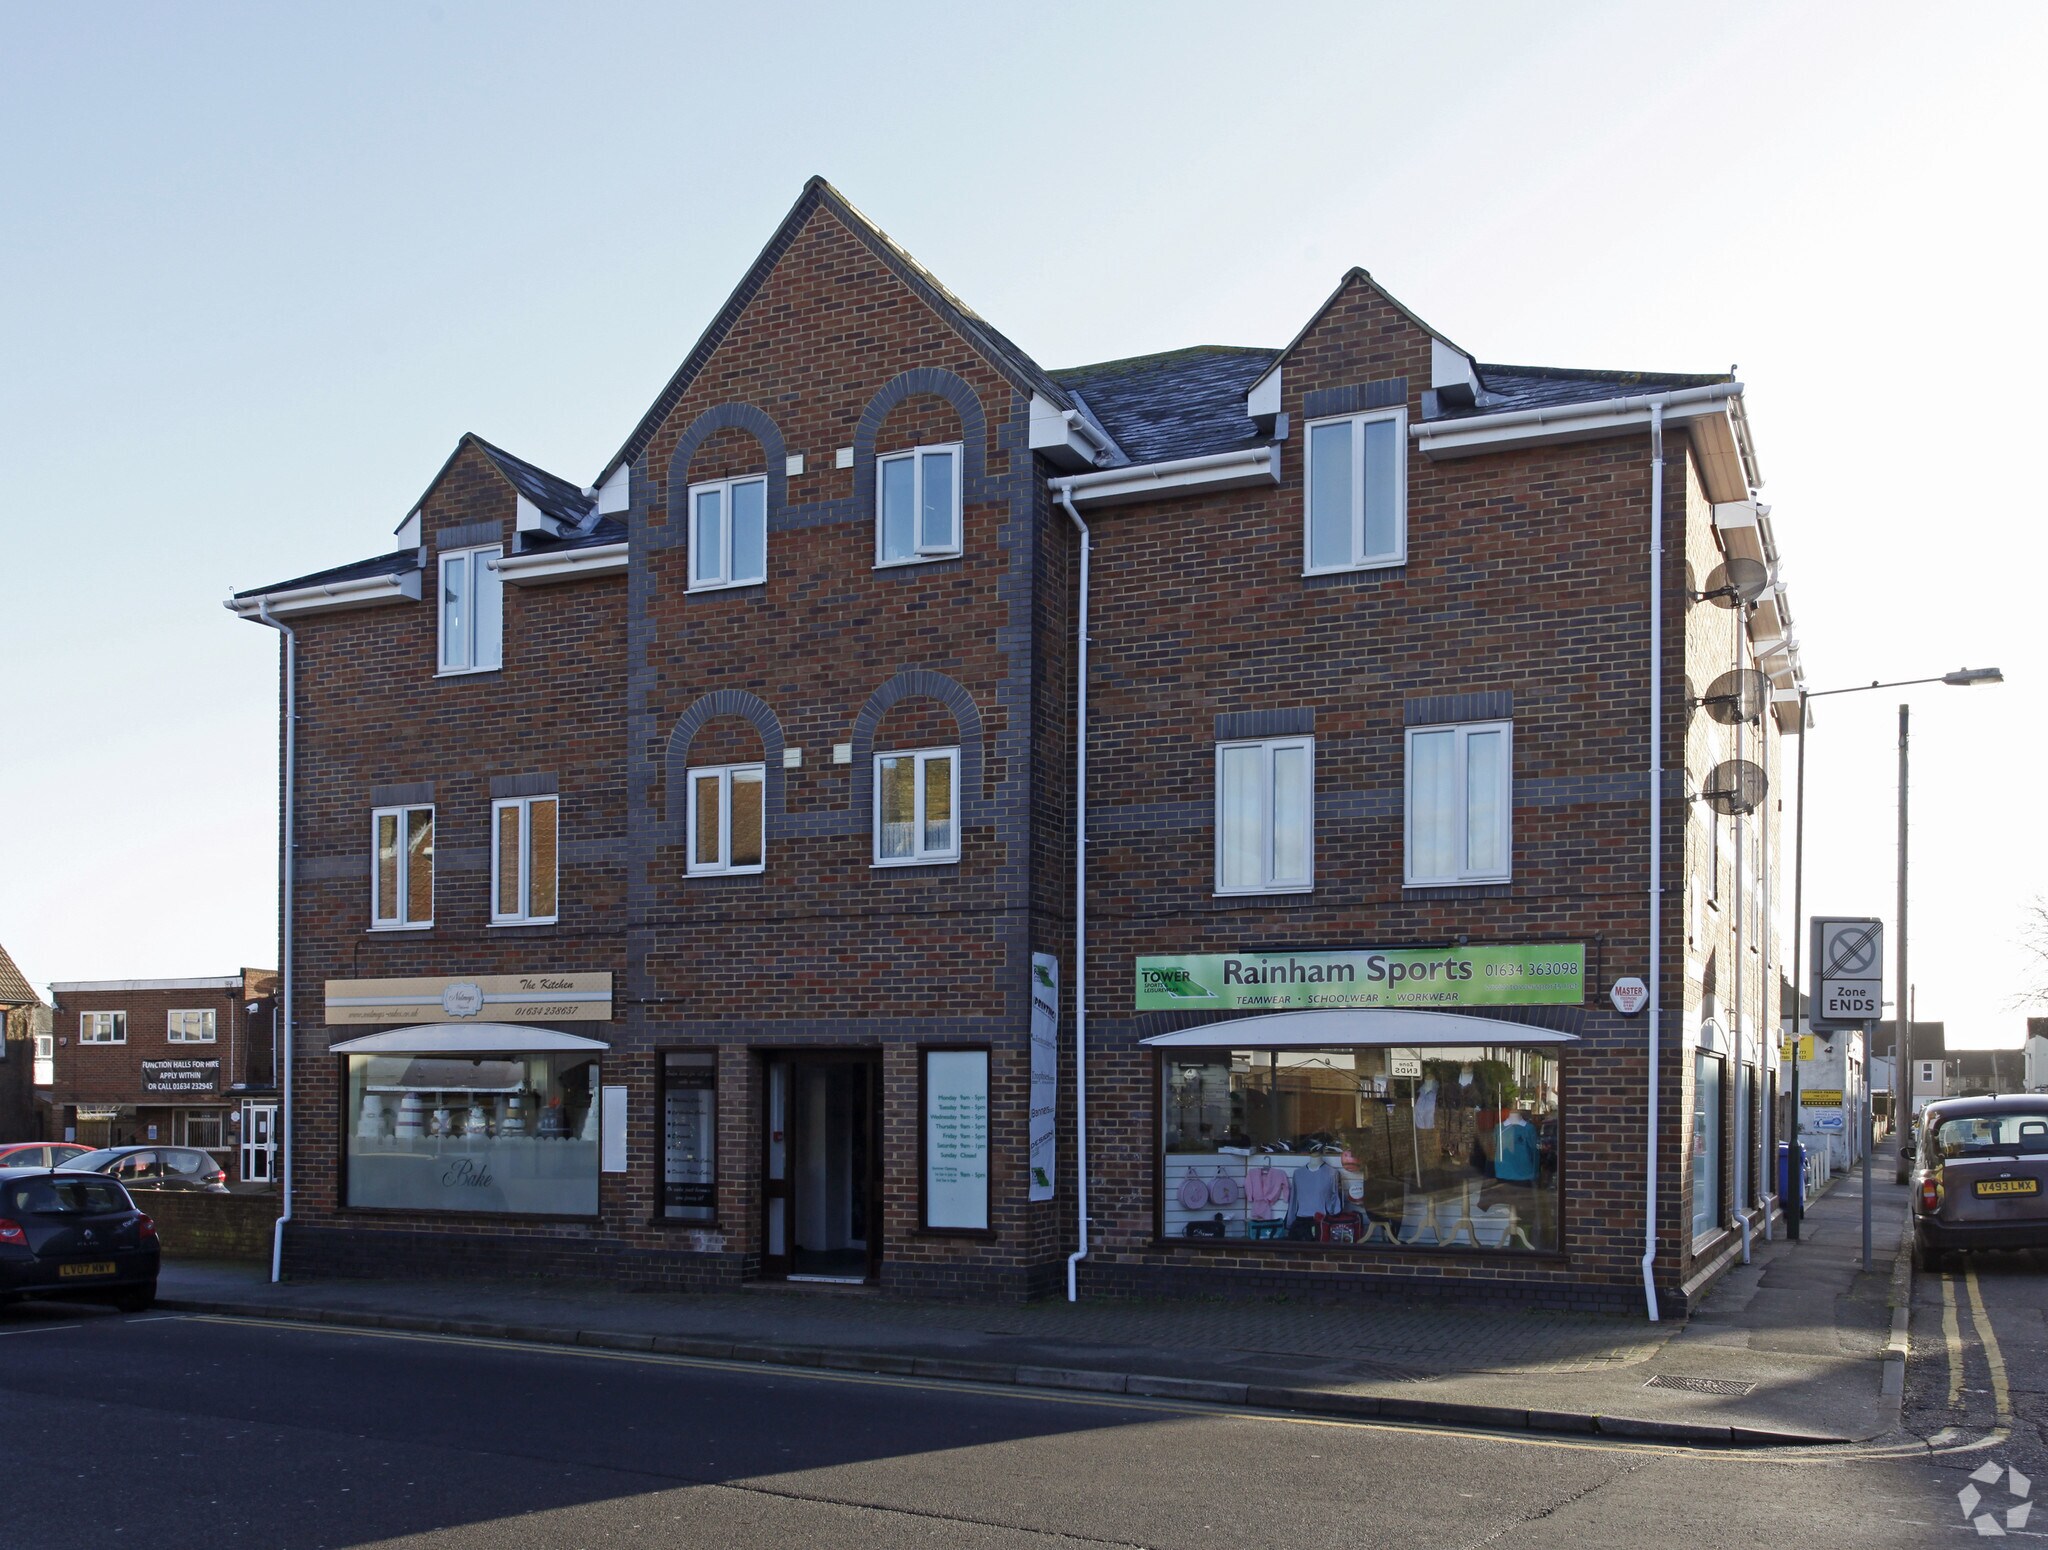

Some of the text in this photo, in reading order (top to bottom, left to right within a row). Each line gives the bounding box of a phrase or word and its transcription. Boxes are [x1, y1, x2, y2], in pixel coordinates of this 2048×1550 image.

[1223, 955, 1473, 989] Rainham Sports
[1485, 962, 1578, 977] 01634 363098
[1141, 971, 1191, 982] TOWER
[520, 978, 574, 990] The Kitchen
[1615, 986, 1642, 996] MASTER
[1838, 987, 1866, 996] Zone
[1236, 992, 1459, 1004] TEAMWEAR SCHOOLWEAR WORKWEAR
[515, 1006, 578, 1016] 01634 238637
[1830, 1000, 1874, 1011] ENDS
[442, 1159, 492, 1188] Bake
[1982, 1182, 2032, 1191] V493 LMX
[64, 1264, 90, 1274] LV07
